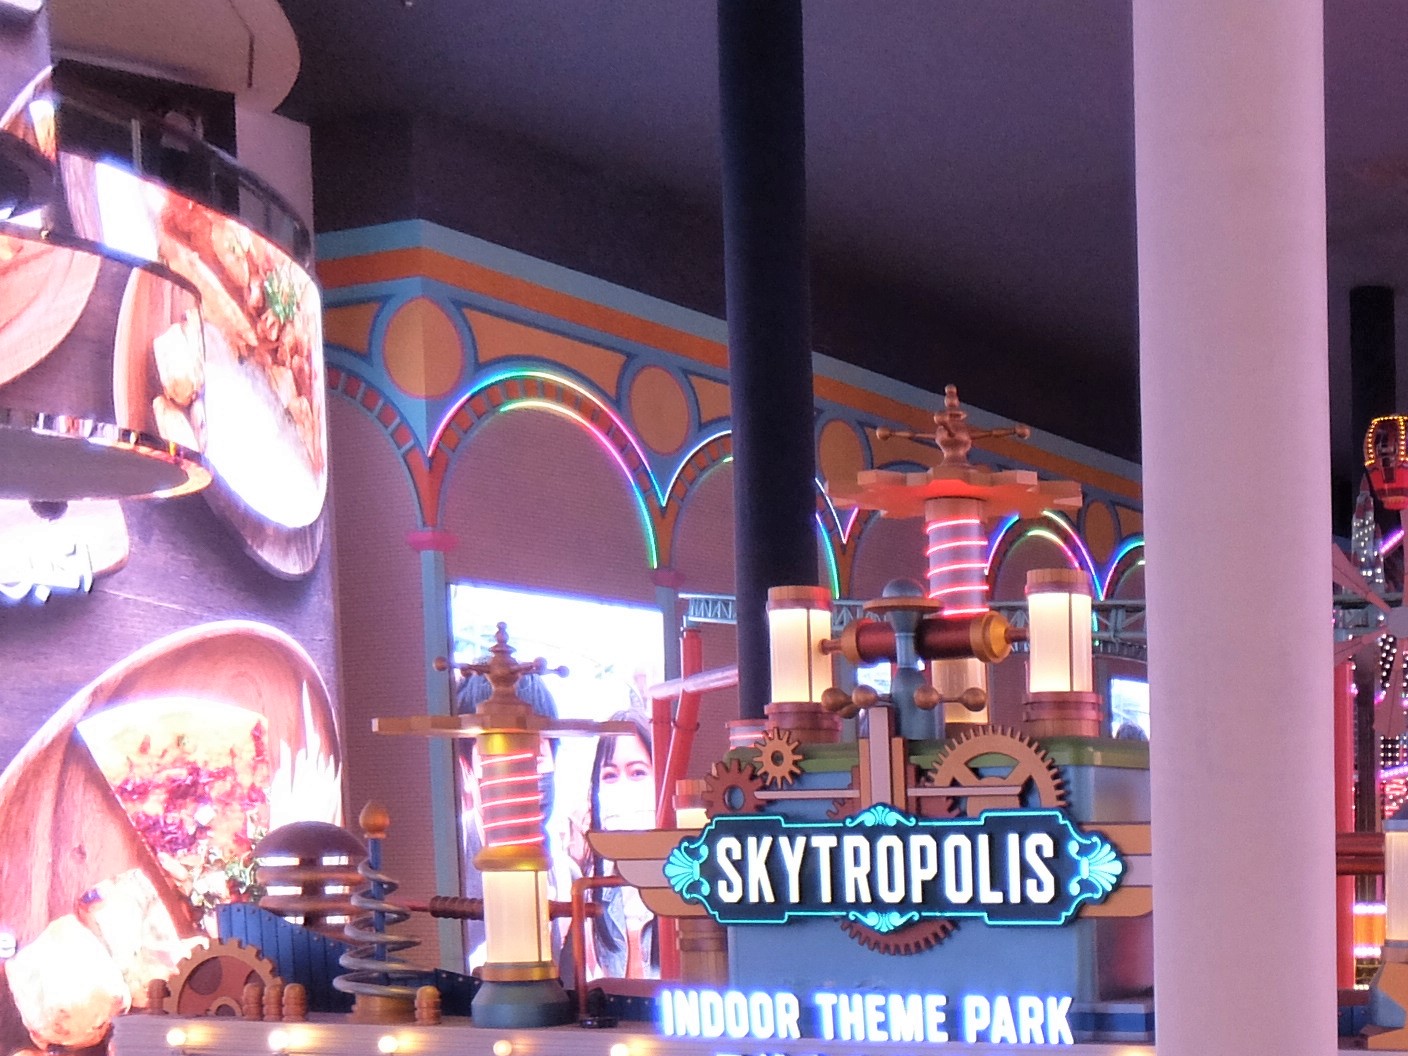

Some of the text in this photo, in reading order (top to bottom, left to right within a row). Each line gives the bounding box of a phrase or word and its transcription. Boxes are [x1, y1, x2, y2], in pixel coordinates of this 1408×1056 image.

[715, 832, 1056, 904] SKYTROPOLIS
[659, 989, 1075, 1045] INDOOR THEME PARK
